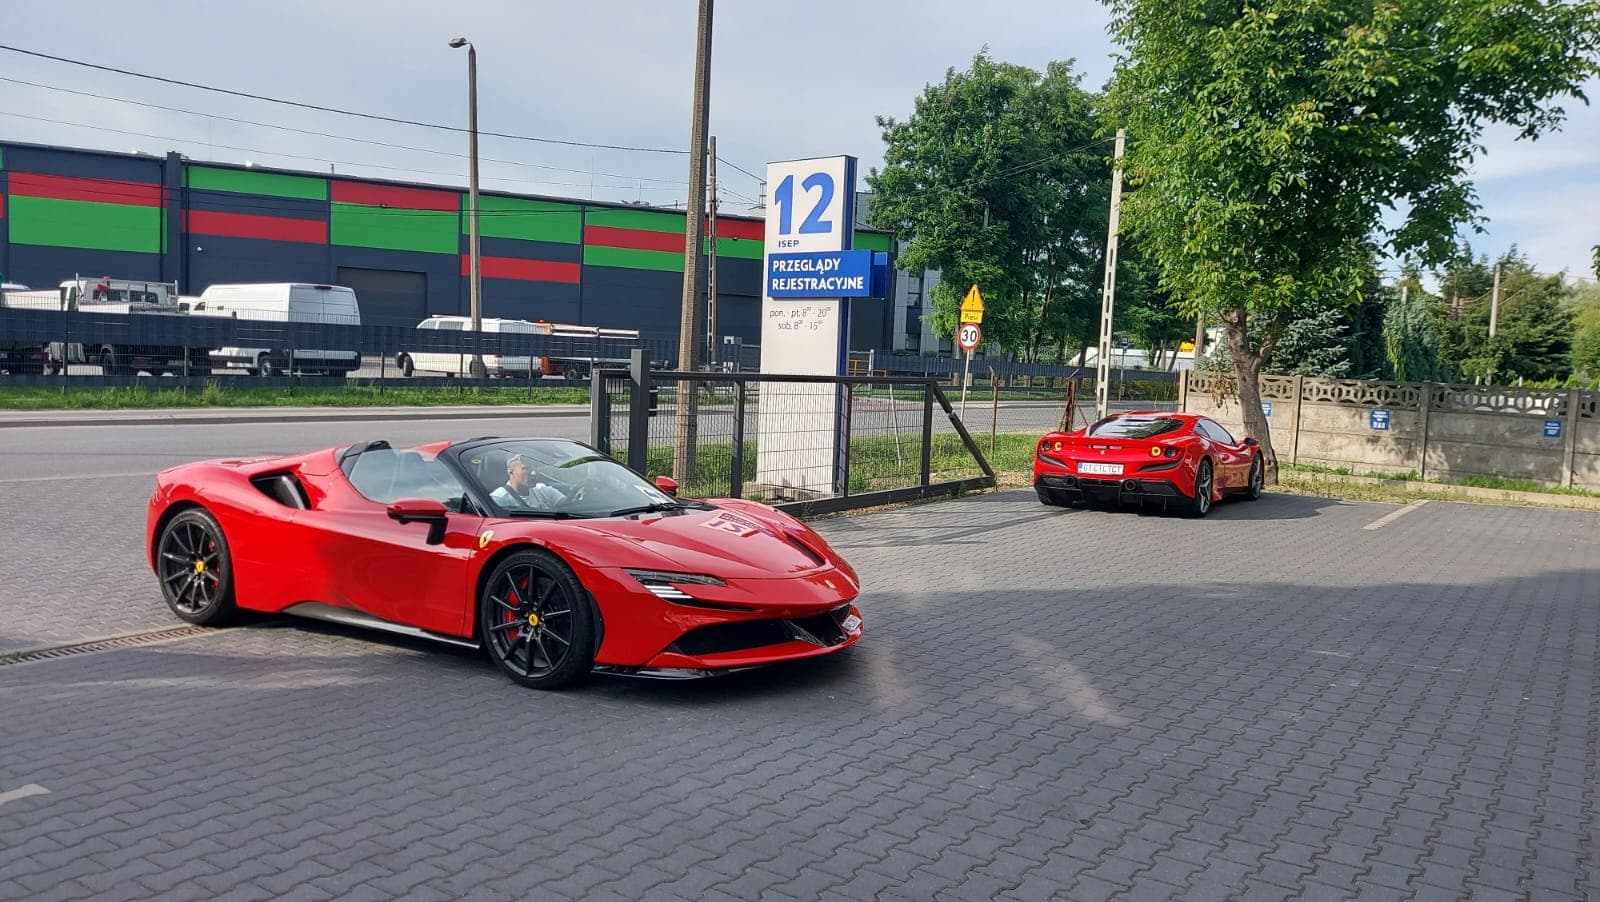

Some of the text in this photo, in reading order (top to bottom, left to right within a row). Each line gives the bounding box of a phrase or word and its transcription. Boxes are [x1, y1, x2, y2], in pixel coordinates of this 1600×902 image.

[775, 172, 834, 235] 12
[778, 240, 800, 248] ISEP
[773, 258, 841, 274] PRZEGLĄDY
[772, 277, 863, 290] REJESTRACYJNE
[770, 310, 786, 318] pon.
[962, 329, 977, 342] 30
